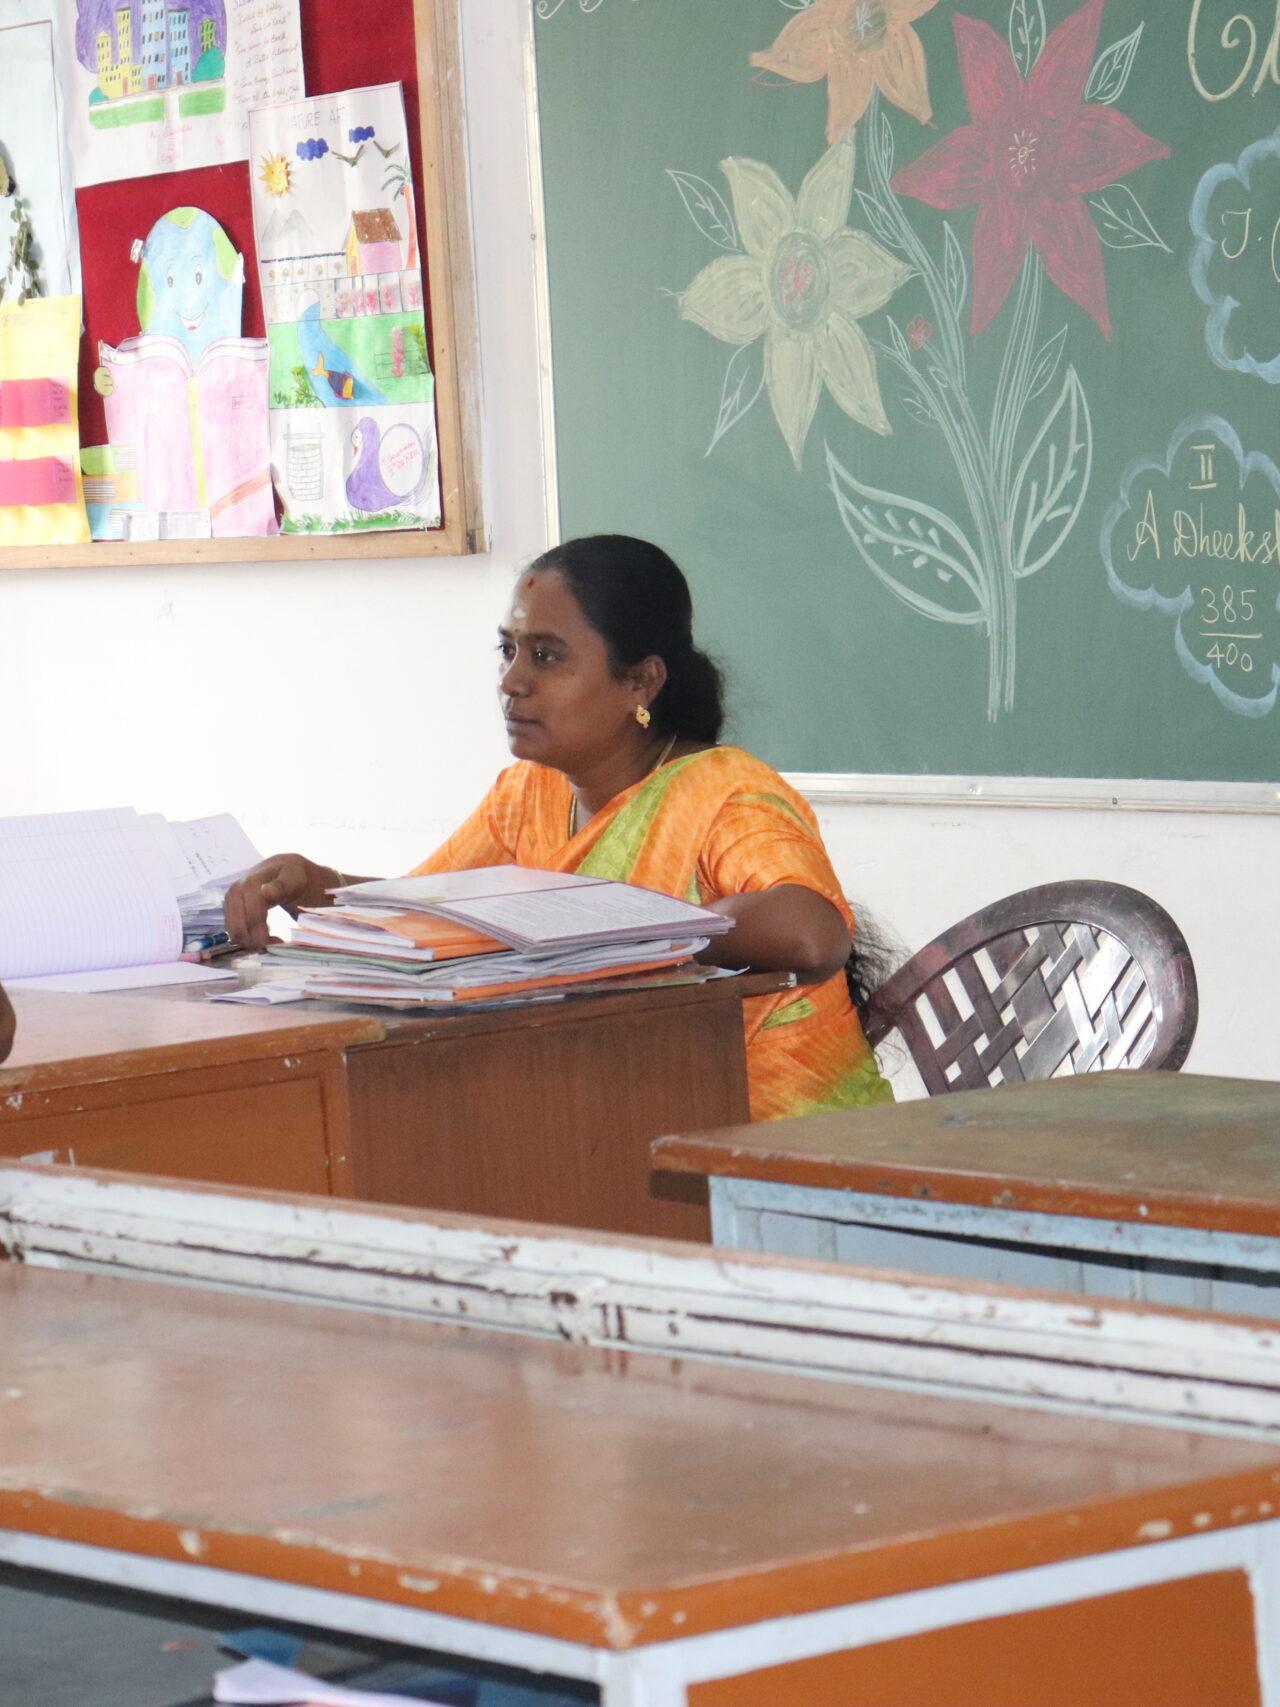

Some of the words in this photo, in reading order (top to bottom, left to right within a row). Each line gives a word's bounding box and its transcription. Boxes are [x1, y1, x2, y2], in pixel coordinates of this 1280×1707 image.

[1189, 444, 1217, 489] II
[1126, 489, 1160, 562] A
[1200, 584, 1256, 624] 385
[1206, 641, 1253, 672] 400
